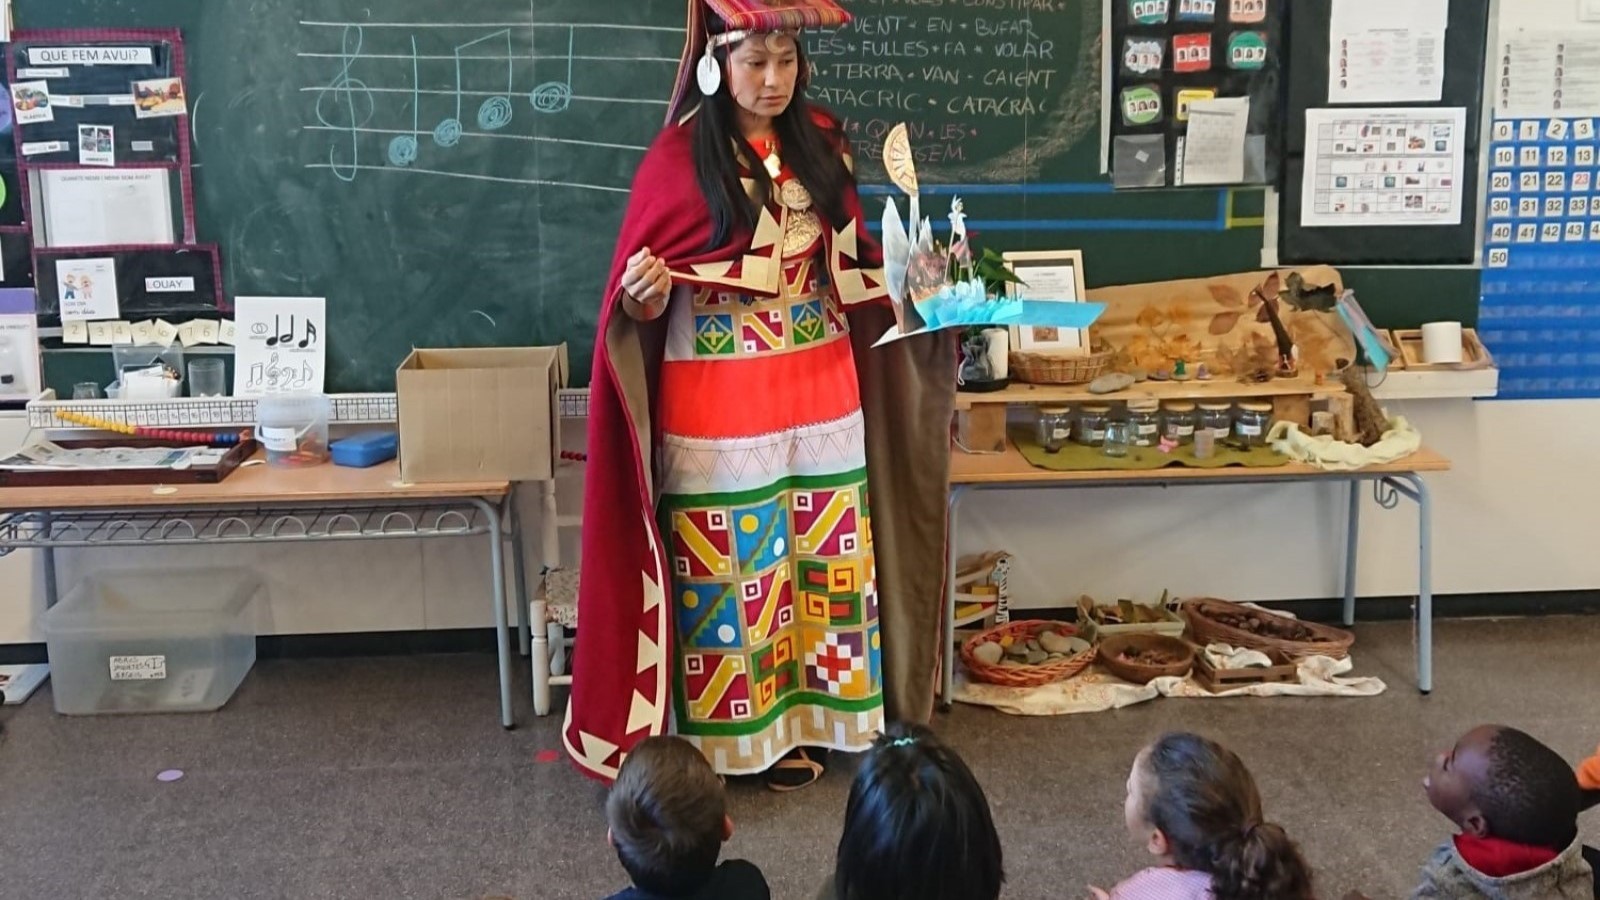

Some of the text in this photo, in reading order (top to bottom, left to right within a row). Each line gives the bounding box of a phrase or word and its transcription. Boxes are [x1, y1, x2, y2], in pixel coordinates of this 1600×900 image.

[854, 15, 907, 35] VENT
[928, 17, 953, 33] EN
[975, 18, 1040, 39] BUFAR
[807, 39, 1054, 59] LES FULLES FA VOLAR
[41, 50, 68, 62] QUE
[72, 50, 98, 61] FEM
[831, 62, 905, 82] TERRA
[922, 65, 959, 85] VAN
[983, 69, 1057, 89] CAIENT
[804, 85, 1047, 117] CATACRIC CATACRAC
[940, 123, 967, 141] LES
[1500, 123, 1588, 136] 0 1 2 3
[1498, 150, 1591, 162] 10 11 12 13
[1494, 174, 1589, 187] 20 21 22 23
[1493, 201, 1508, 211] 30
[1522, 201, 1536, 211] 31
[1547, 201, 1561, 211] 32
[1571, 200, 1585, 210] 33
[1494, 227, 1510, 238] 40
[1520, 227, 1534, 238] 41
[1544, 226, 1559, 236] 42
[1567, 225, 1582, 235] 43
[1491, 253, 1507, 263] 50
[147, 279, 183, 289] LOUAY
[71, 324, 78, 334] 2
[97, 326, 104, 336] 3
[115, 325, 123, 334] 4
[139, 327, 148, 336] 5
[185, 326, 193, 337] 7
[227, 327, 234, 337] 8
